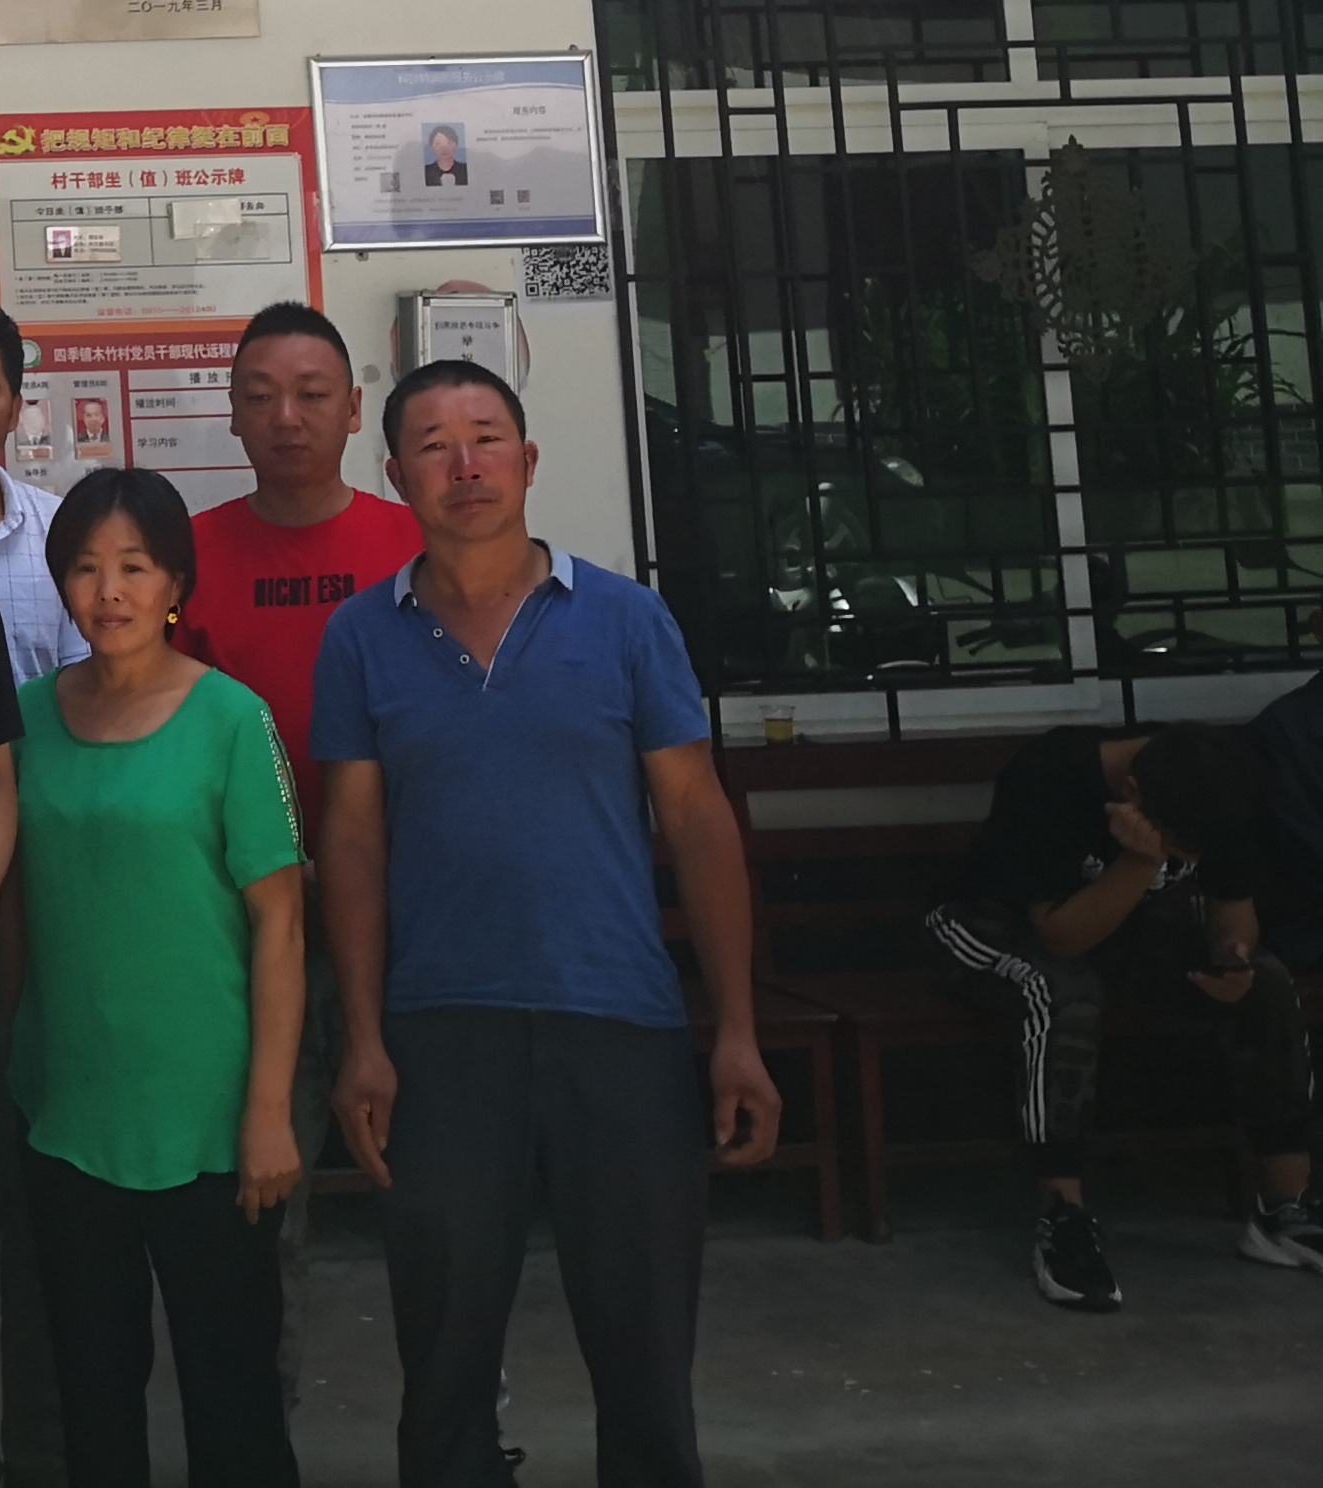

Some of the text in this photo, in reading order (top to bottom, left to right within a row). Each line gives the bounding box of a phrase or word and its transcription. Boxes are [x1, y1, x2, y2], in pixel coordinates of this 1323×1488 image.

[40, 123, 290, 154] 把规矩和纪律挺在前面
[137, 437, 178, 449] 学习内容
